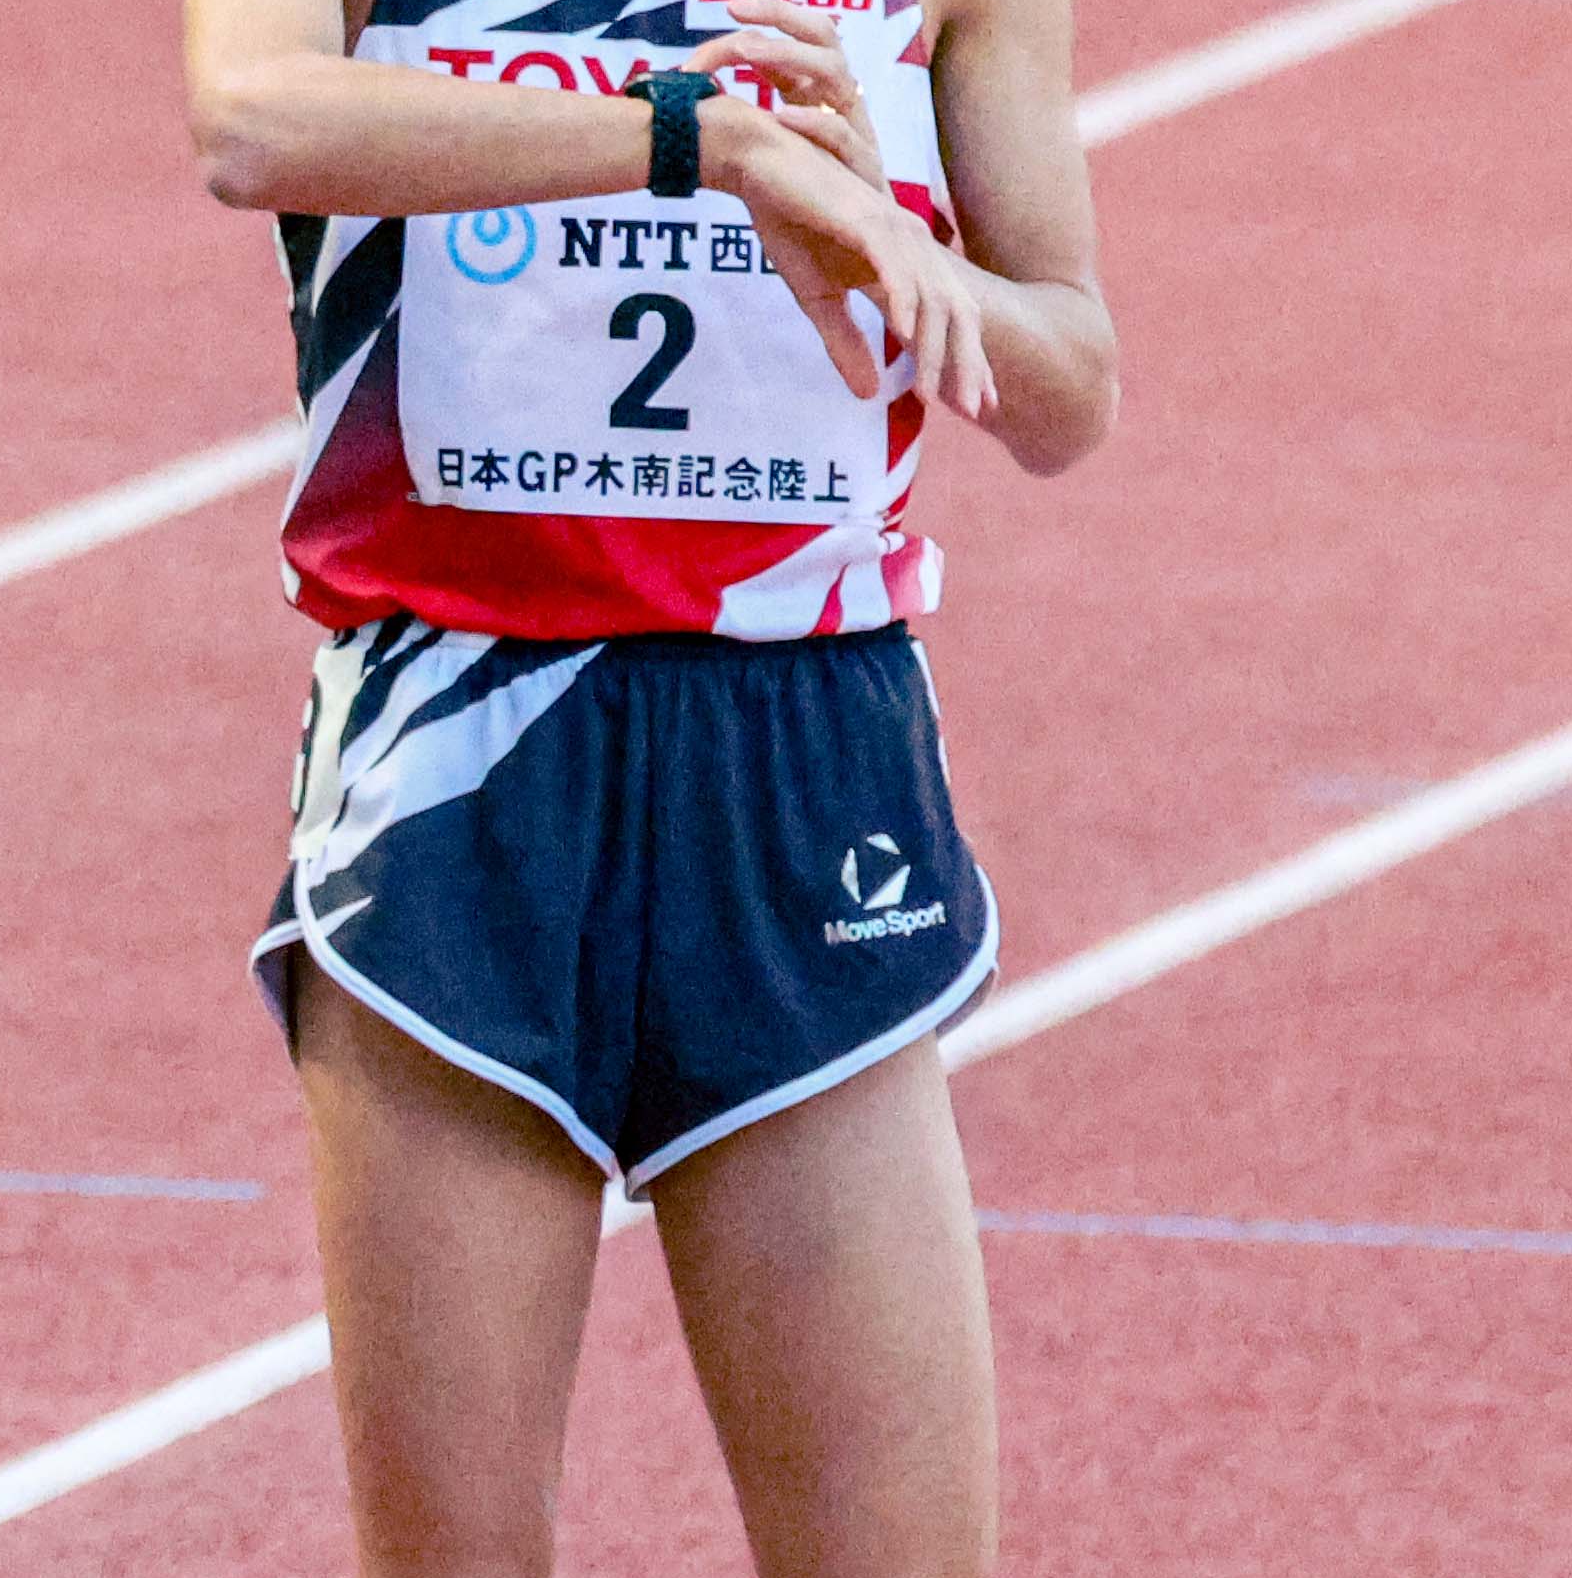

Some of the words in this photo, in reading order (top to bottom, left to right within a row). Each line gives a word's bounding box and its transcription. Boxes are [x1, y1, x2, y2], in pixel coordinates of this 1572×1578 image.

[608, 293, 697, 431] 2
[437, 447, 850, 504] 日本GP木南記念陸上
